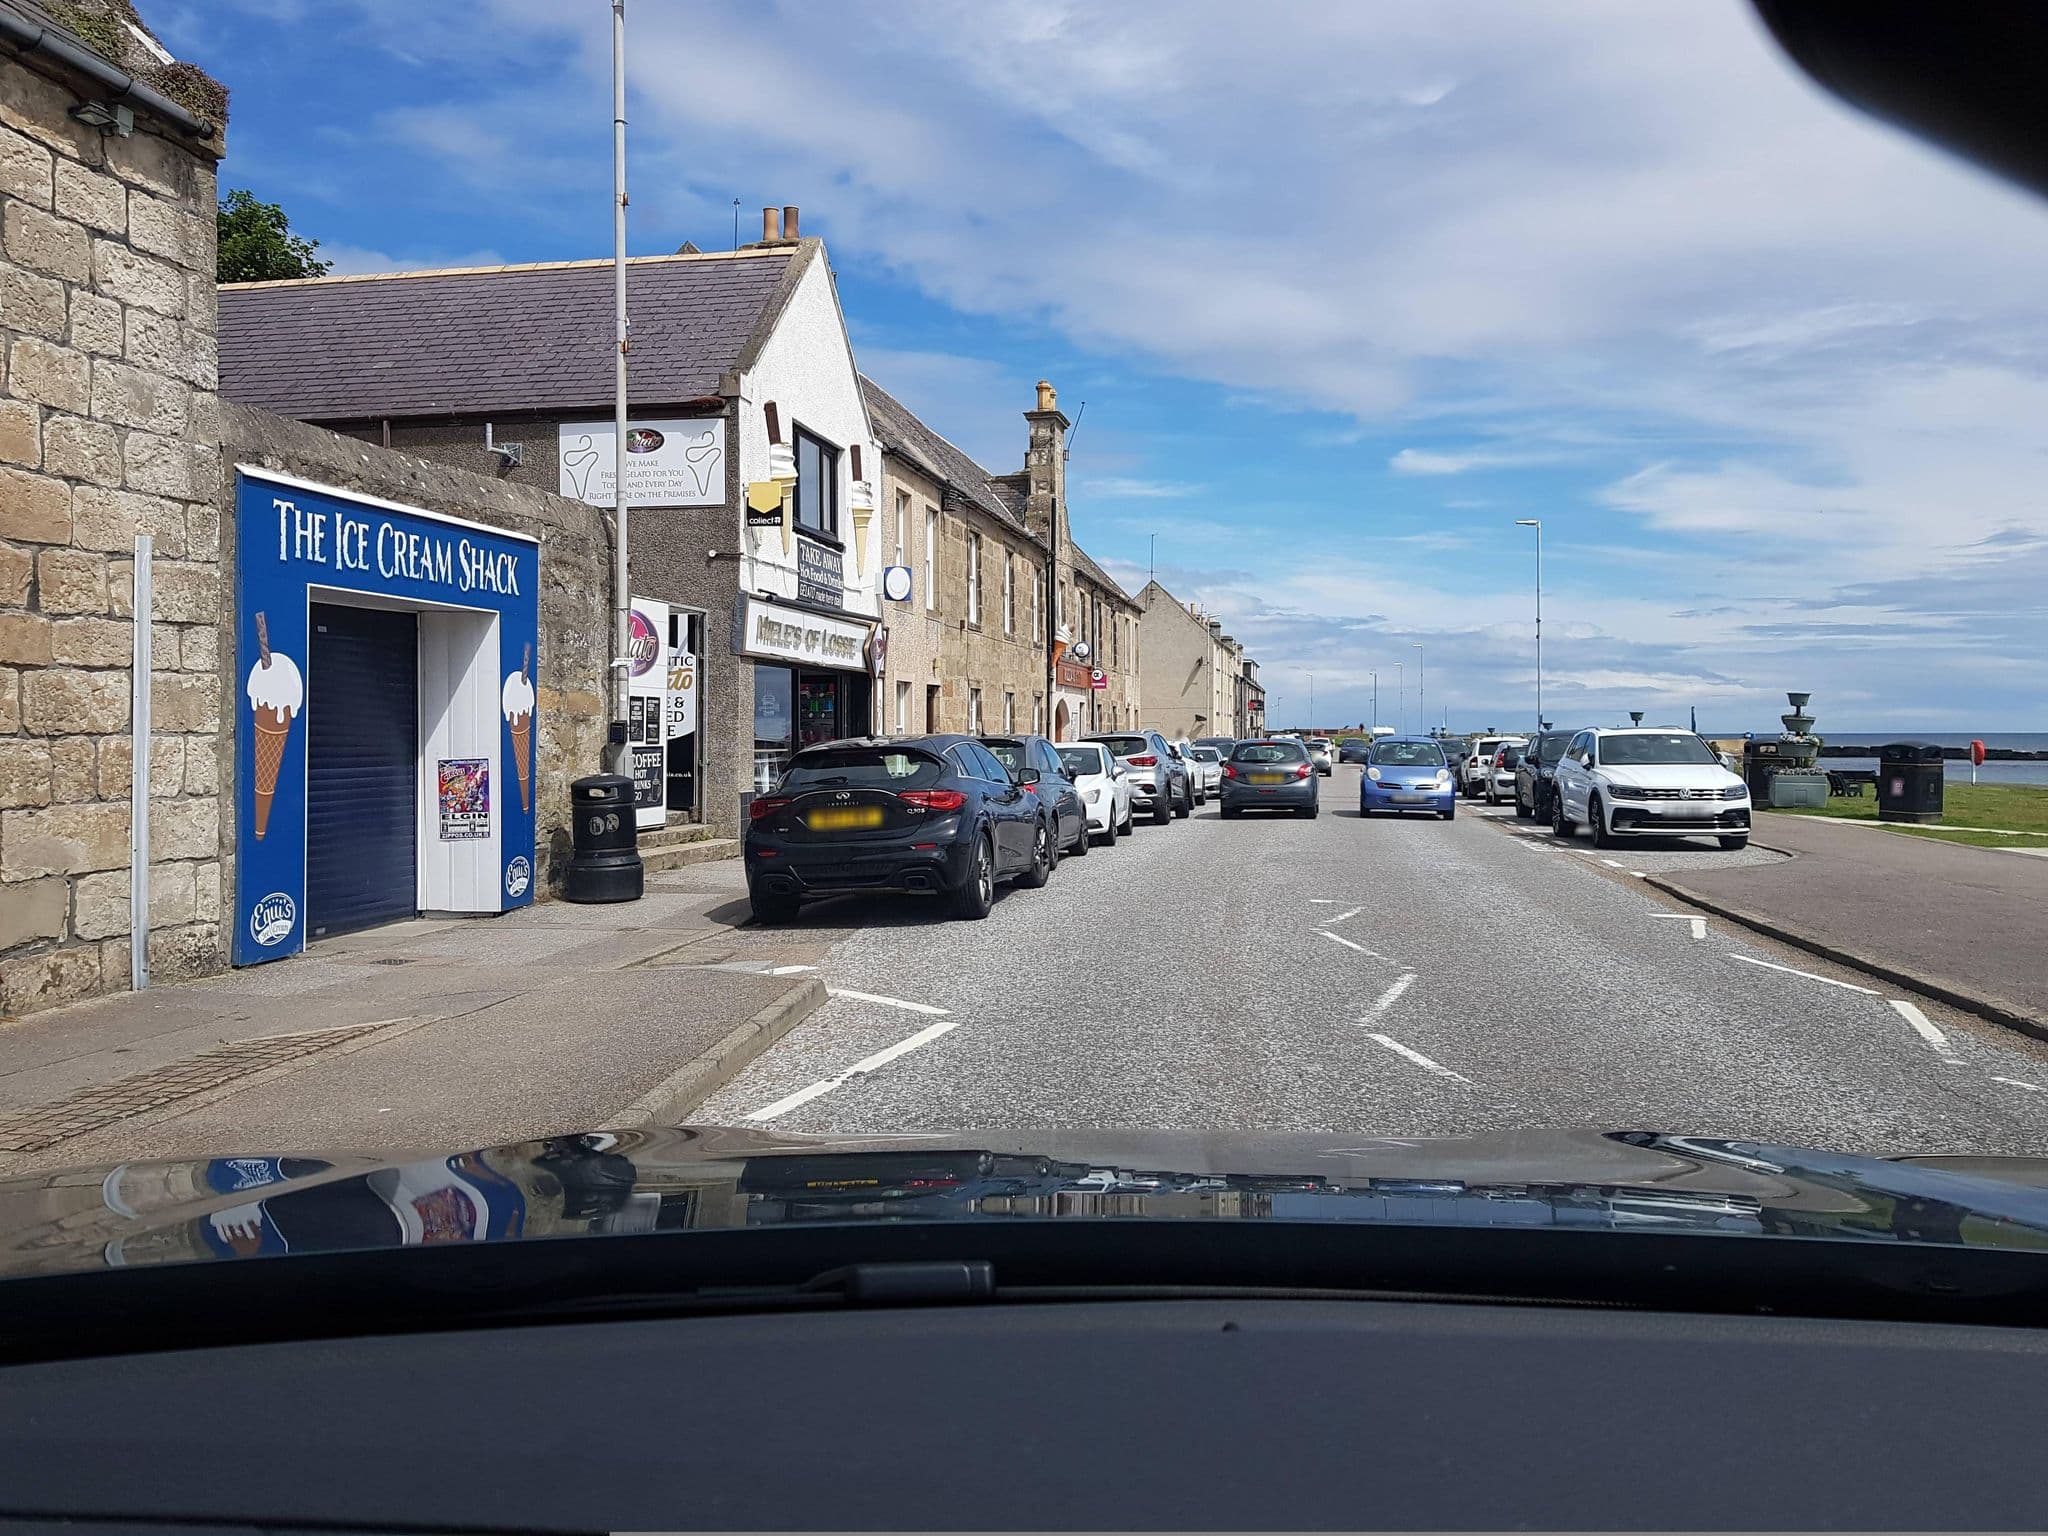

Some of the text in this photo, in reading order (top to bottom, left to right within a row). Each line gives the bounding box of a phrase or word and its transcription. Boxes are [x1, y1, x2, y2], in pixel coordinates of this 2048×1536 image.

[638, 459, 659, 467] MAKE
[601, 471, 617, 479] FRES
[667, 468, 684, 477] YOU
[627, 480, 643, 488] AND
[645, 479, 667, 488] EVERY
[668, 479, 683, 487] DAY
[589, 492, 613, 500] RIGHT
[634, 491, 646, 499] ON
[647, 490, 663, 498] THE
[663, 489, 696, 498] PREMISES
[273, 498, 521, 596] THE ICE CREAM SHACK
[800, 543, 842, 573] TAKE AWAY
[804, 628, 821, 653] OF
[821, 629, 857, 659] LOSSIE
[441, 812, 489, 820] ELGIN
